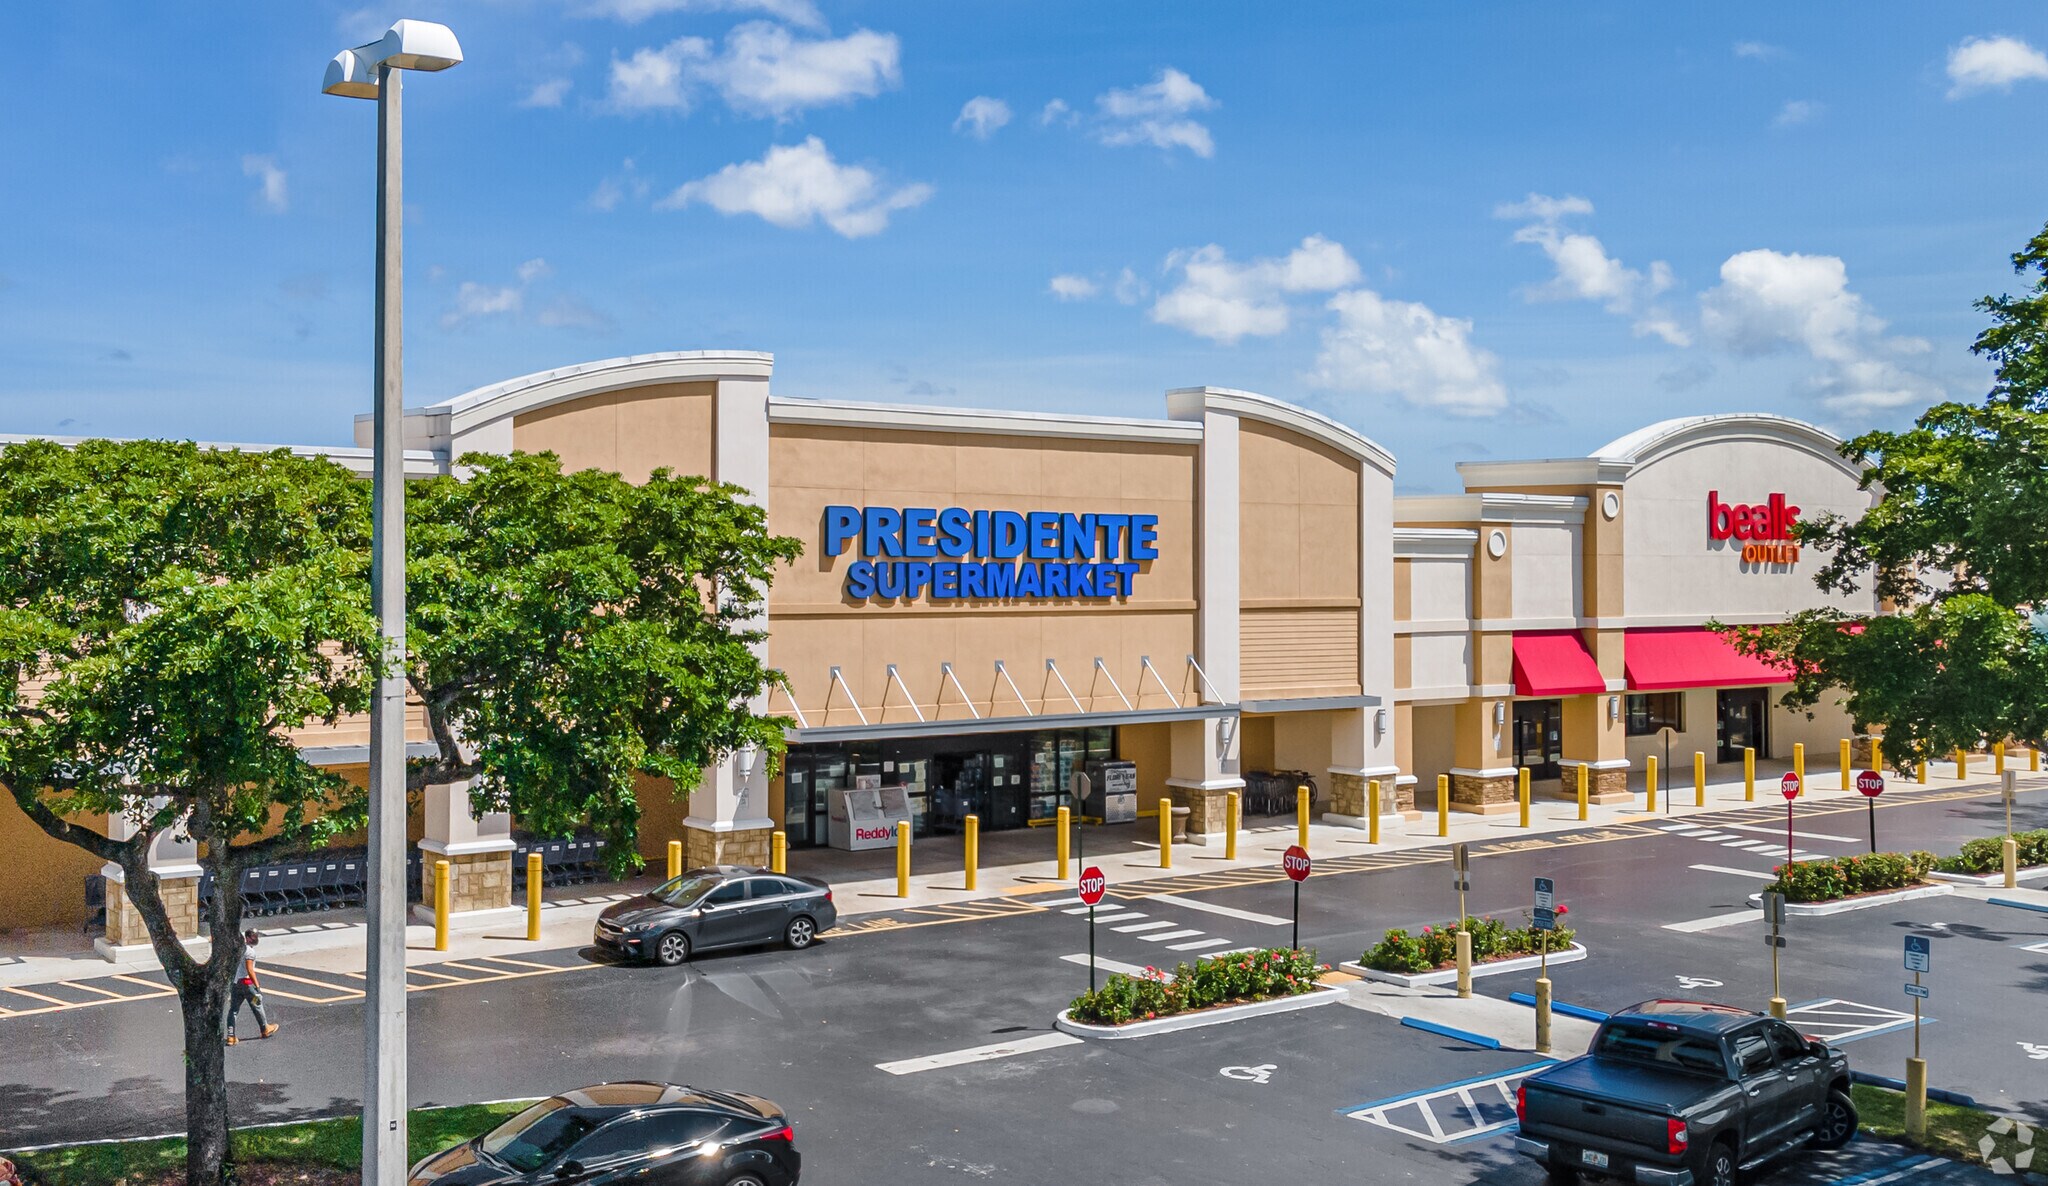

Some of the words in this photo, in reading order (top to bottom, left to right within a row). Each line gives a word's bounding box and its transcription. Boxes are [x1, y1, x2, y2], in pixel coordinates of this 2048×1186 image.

[1708, 490, 1801, 541] bealls
[825, 505, 1160, 560] PRESIDENTE
[1742, 544, 1801, 563] OUTLET
[847, 561, 1140, 599] SUPERMARKET
[1782, 780, 1799, 792] STOP
[1858, 778, 1883, 790] STOP
[856, 826, 899, 841] ReddyIc
[1285, 855, 1310, 871] STOP
[1080, 877, 1104, 895] STOP
